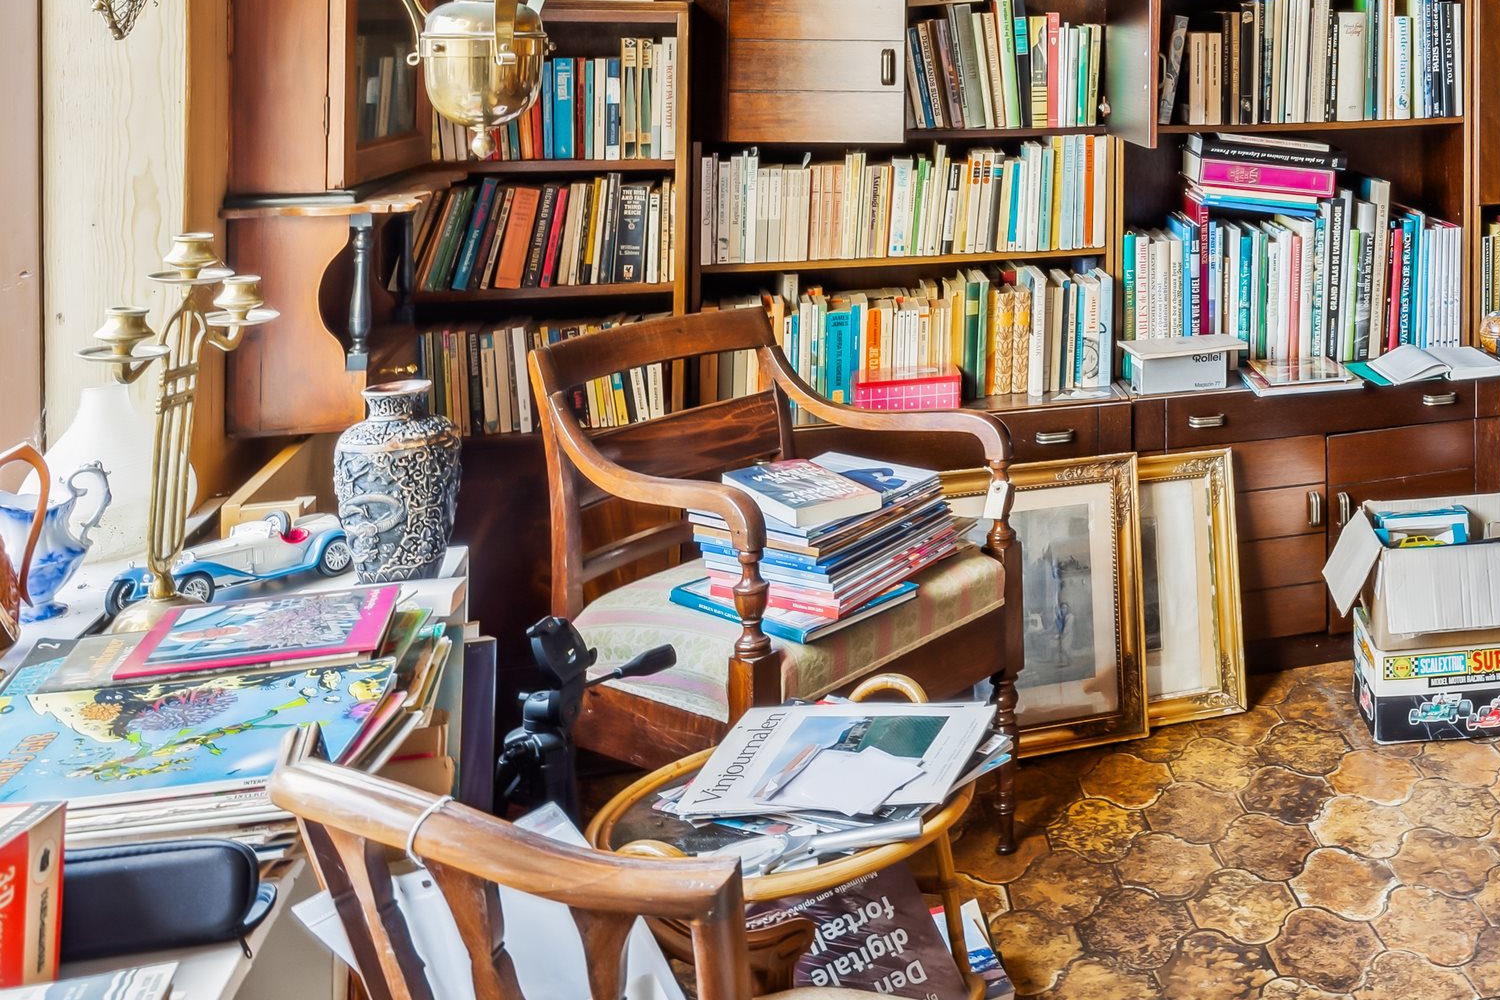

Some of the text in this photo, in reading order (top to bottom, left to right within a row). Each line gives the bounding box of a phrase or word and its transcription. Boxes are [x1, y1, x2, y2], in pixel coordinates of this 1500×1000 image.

[1446, 33, 1452, 45] UN
[1398, 17, 1409, 92] guide clause
[1432, 46, 1440, 72] PARIS
[921, 35, 940, 117] DERES MANDS SUCCES
[1248, 167, 1258, 184] VIN
[541, 187, 553, 218] RICHARD
[703, 160, 711, 225] Oiseaux chanteurs
[535, 220, 546, 246] WRIGHT
[1137, 242, 1147, 279] Fontaine
[1331, 256, 1339, 264] DE
[1403, 266, 1410, 276] DE
[1137, 281, 1147, 293] La
[1330, 265, 1338, 285] ATLAS
[1192, 294, 1199, 304] DU
[1137, 304, 1148, 339] ABLES
[1192, 319, 1200, 336] ANCE
[1192, 353, 1221, 362] Rollei
[1420, 655, 1465, 674] SCALEXTRIC
[1431, 677, 1448, 686] MODEL
[1467, 674, 1485, 683] RACING
[692, 712, 788, 805] Vinjournalen
[816, 870, 879, 901] Multimedie som
[811, 928, 909, 986] digitale
[873, 960, 928, 993] Den
